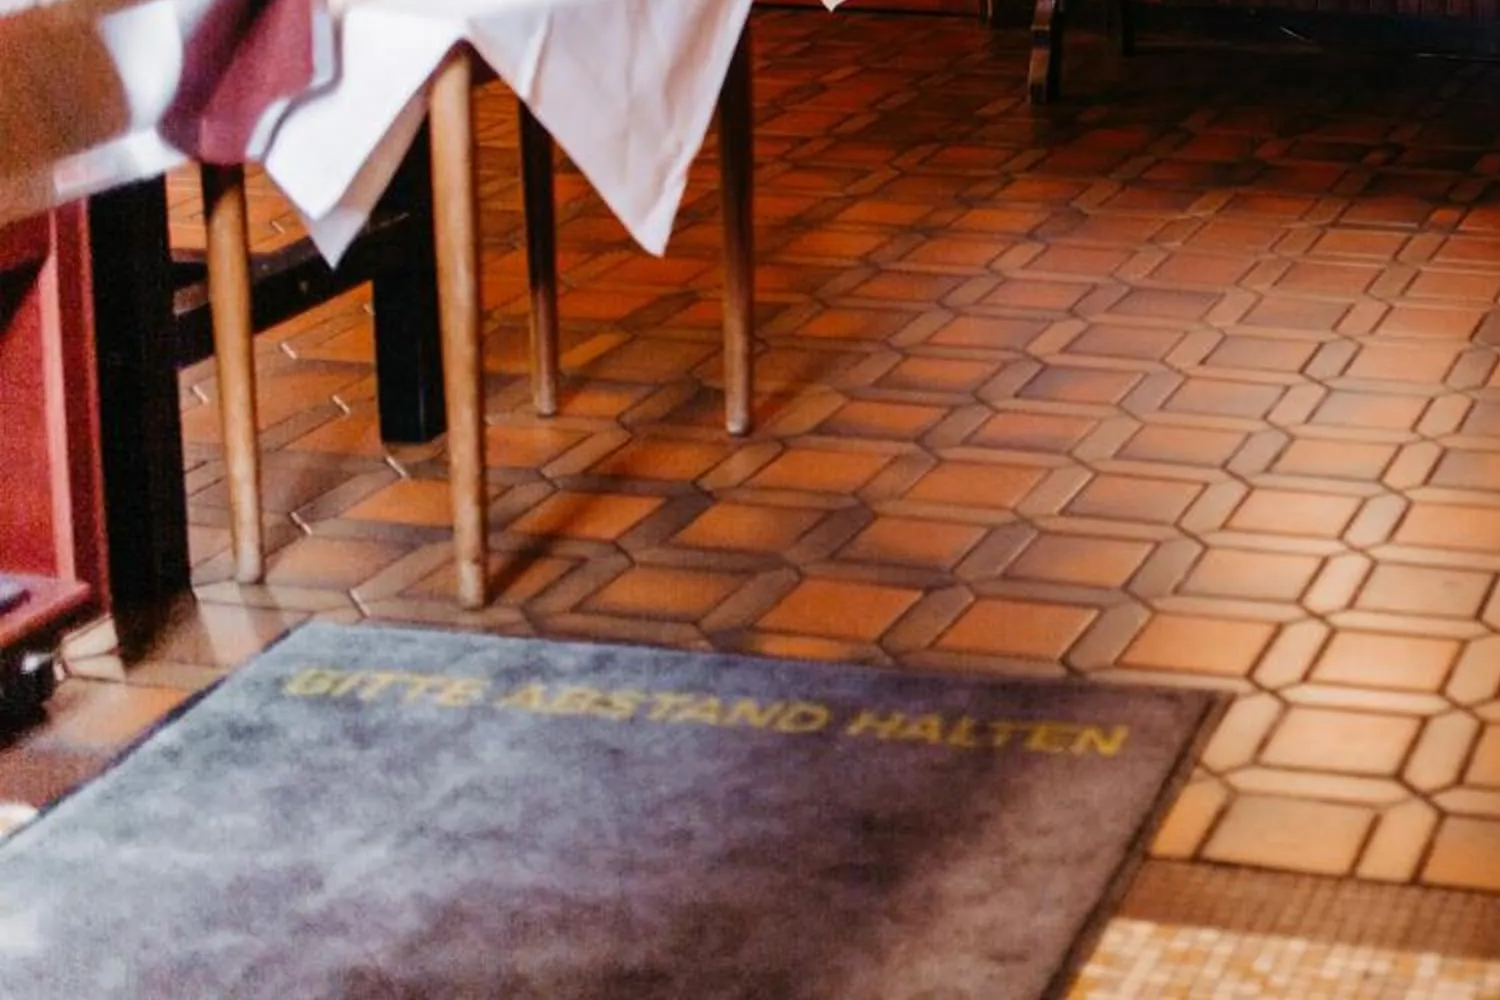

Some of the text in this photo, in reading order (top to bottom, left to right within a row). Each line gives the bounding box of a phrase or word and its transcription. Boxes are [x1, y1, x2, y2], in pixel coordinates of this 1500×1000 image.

[282, 668, 1130, 756] BITTE ABSTAND HALTEN
